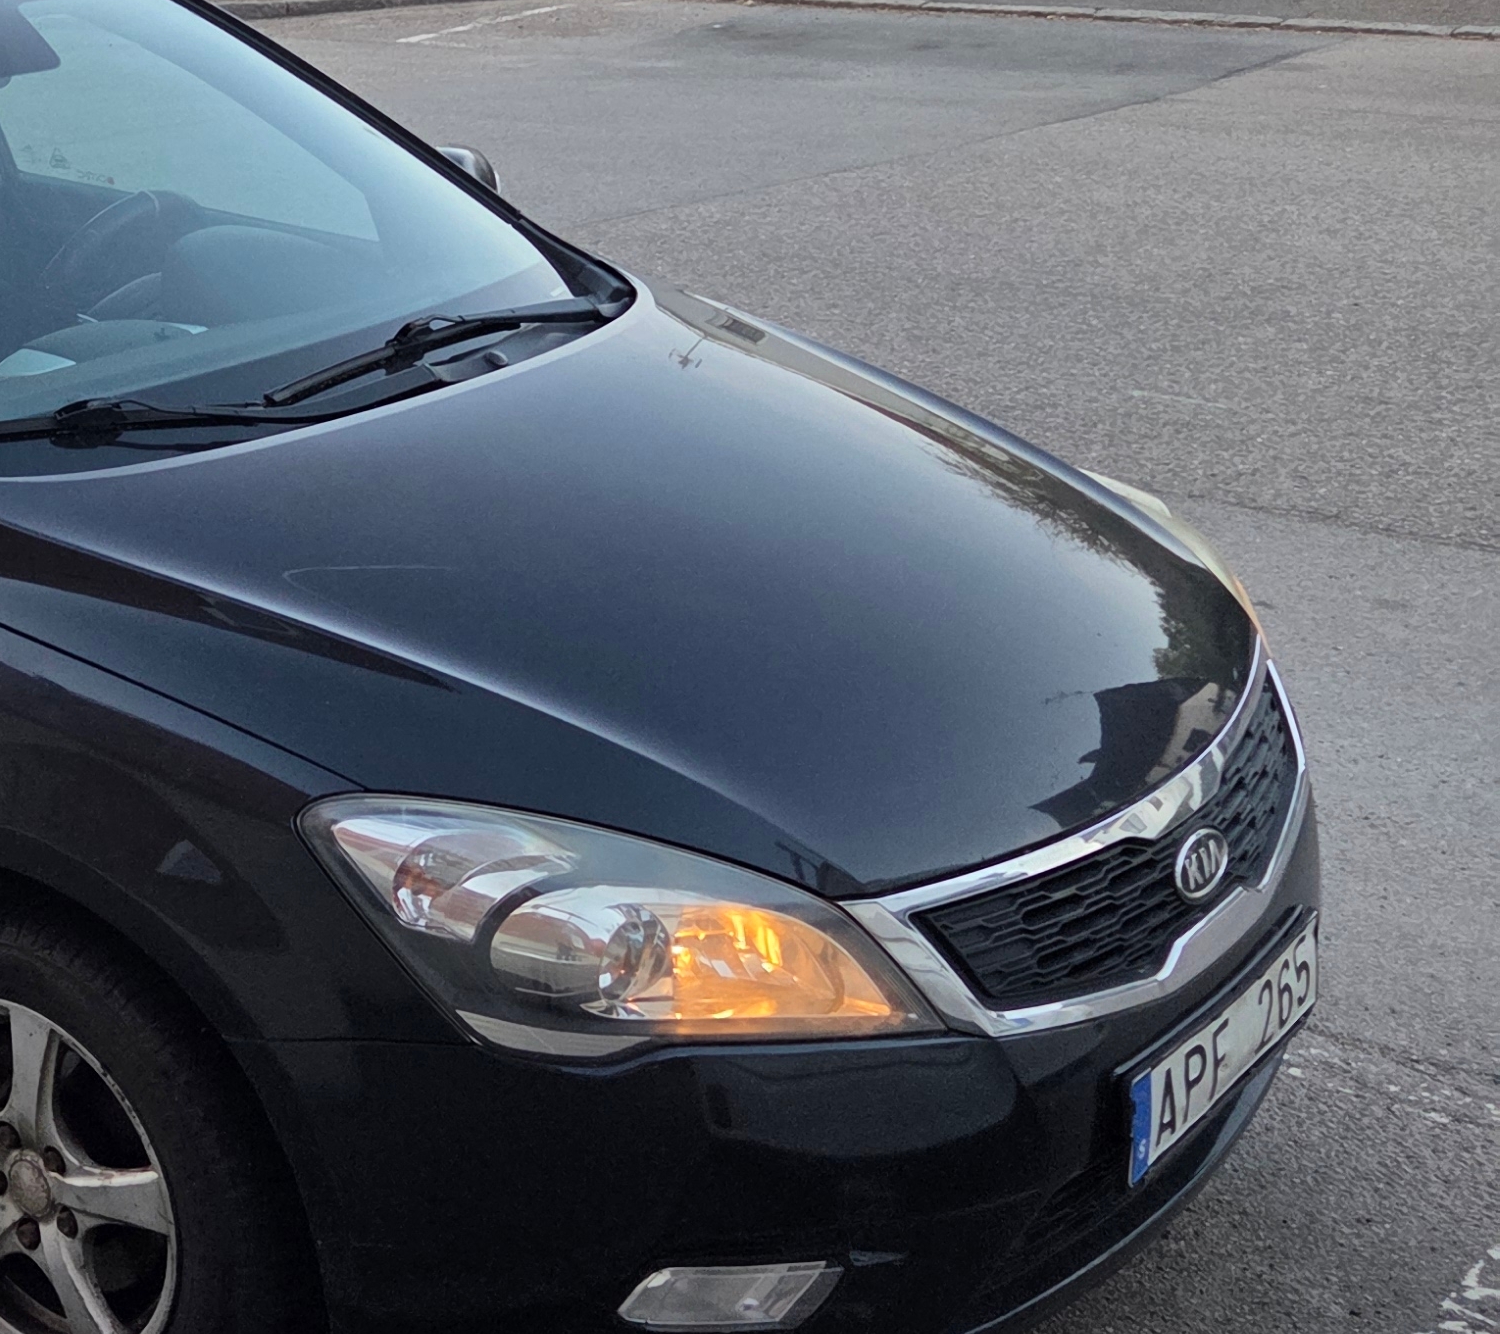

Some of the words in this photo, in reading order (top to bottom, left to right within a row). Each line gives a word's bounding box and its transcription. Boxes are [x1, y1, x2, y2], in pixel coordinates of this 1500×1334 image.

[1184, 839, 1222, 890] KIA
[1155, 1018, 1230, 1147] APF
[1254, 934, 1311, 1055] 265
[1137, 1138, 1147, 1160] S
